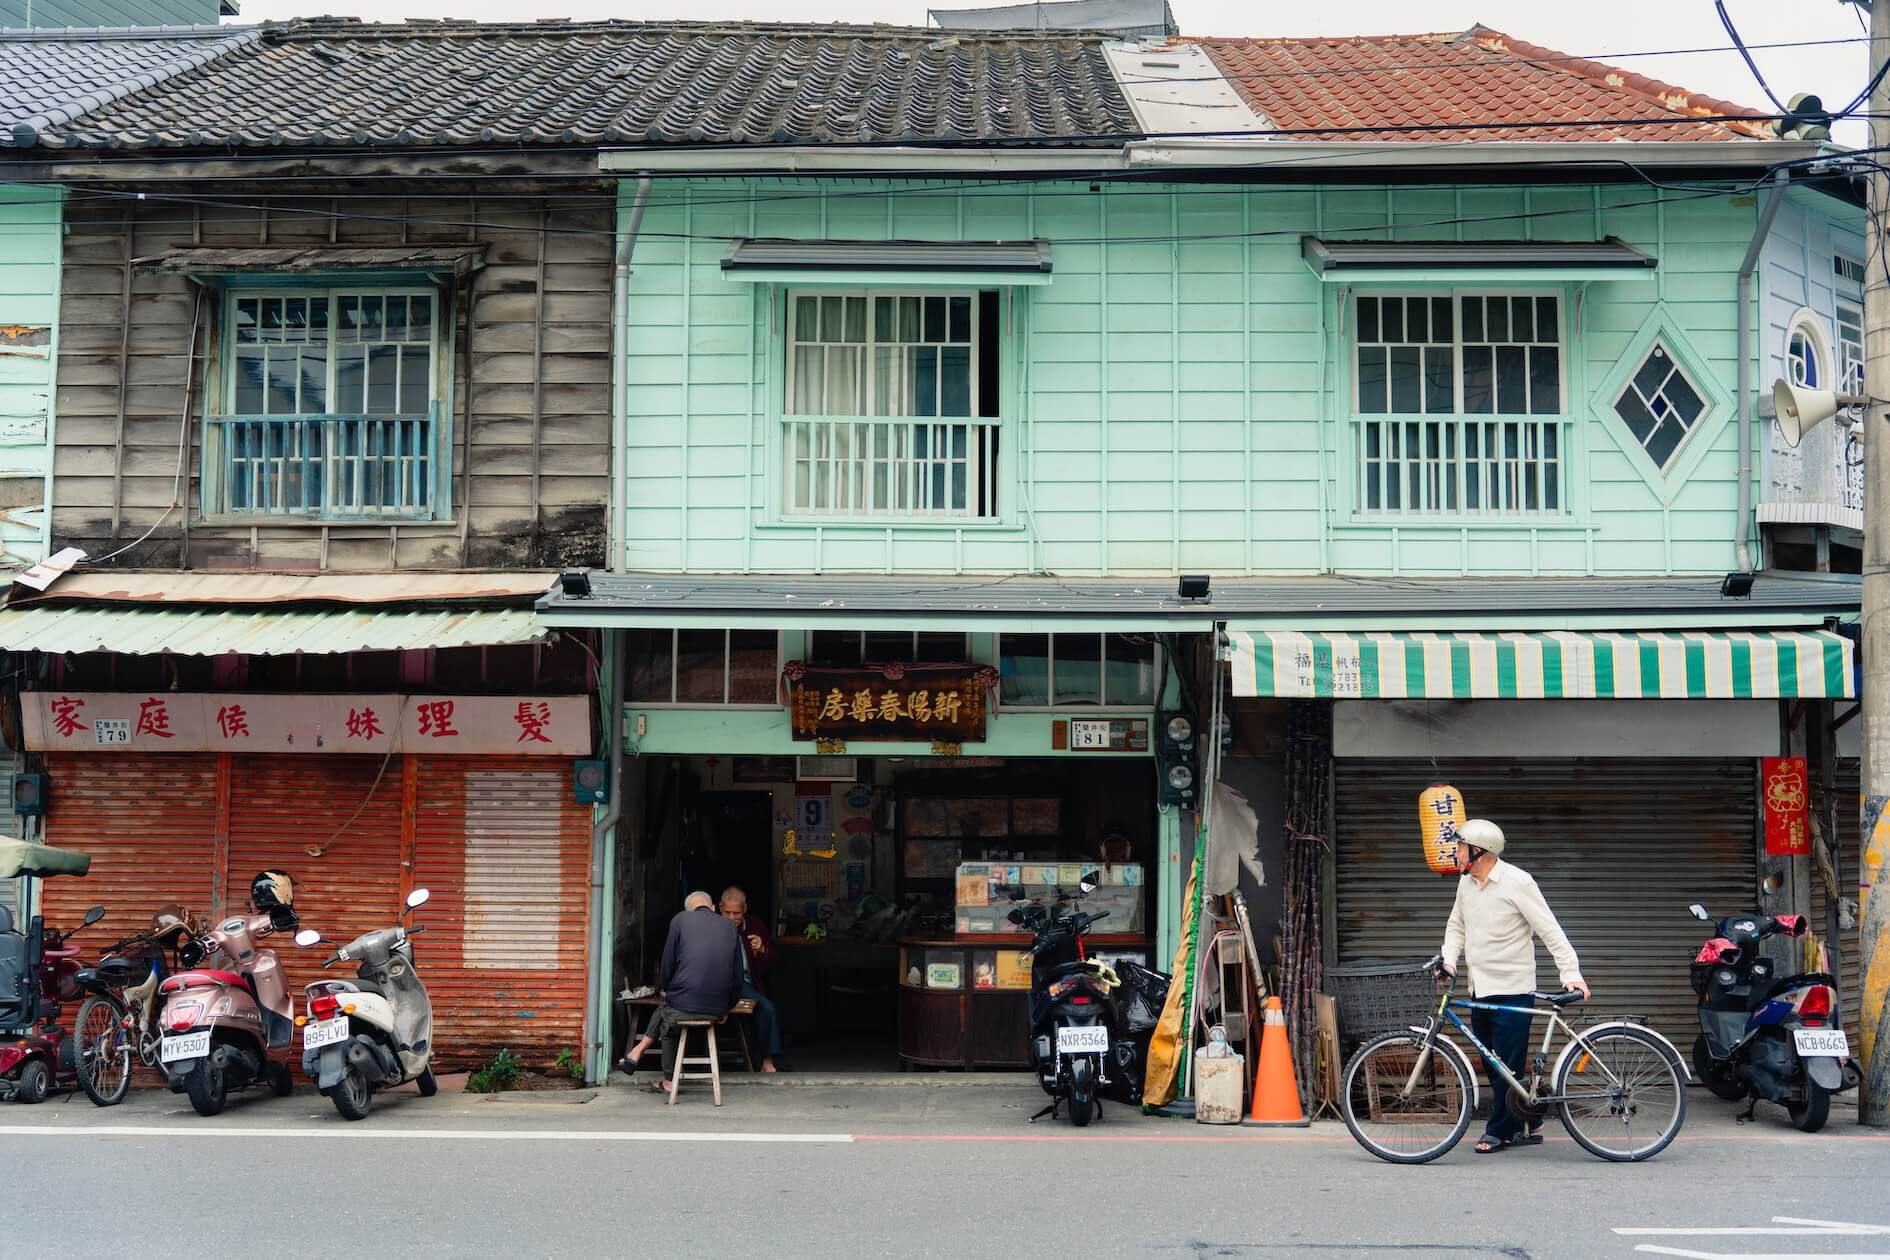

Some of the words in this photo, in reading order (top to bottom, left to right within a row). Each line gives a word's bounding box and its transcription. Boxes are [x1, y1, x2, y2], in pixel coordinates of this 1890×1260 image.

[1084, 733, 1102, 744] 81
[805, 800, 821, 826] 9
[305, 1024, 347, 1046] 895-LVU
[1061, 1033, 1106, 1047] NXR-5366
[1797, 1037, 1846, 1050] NCB-8665
